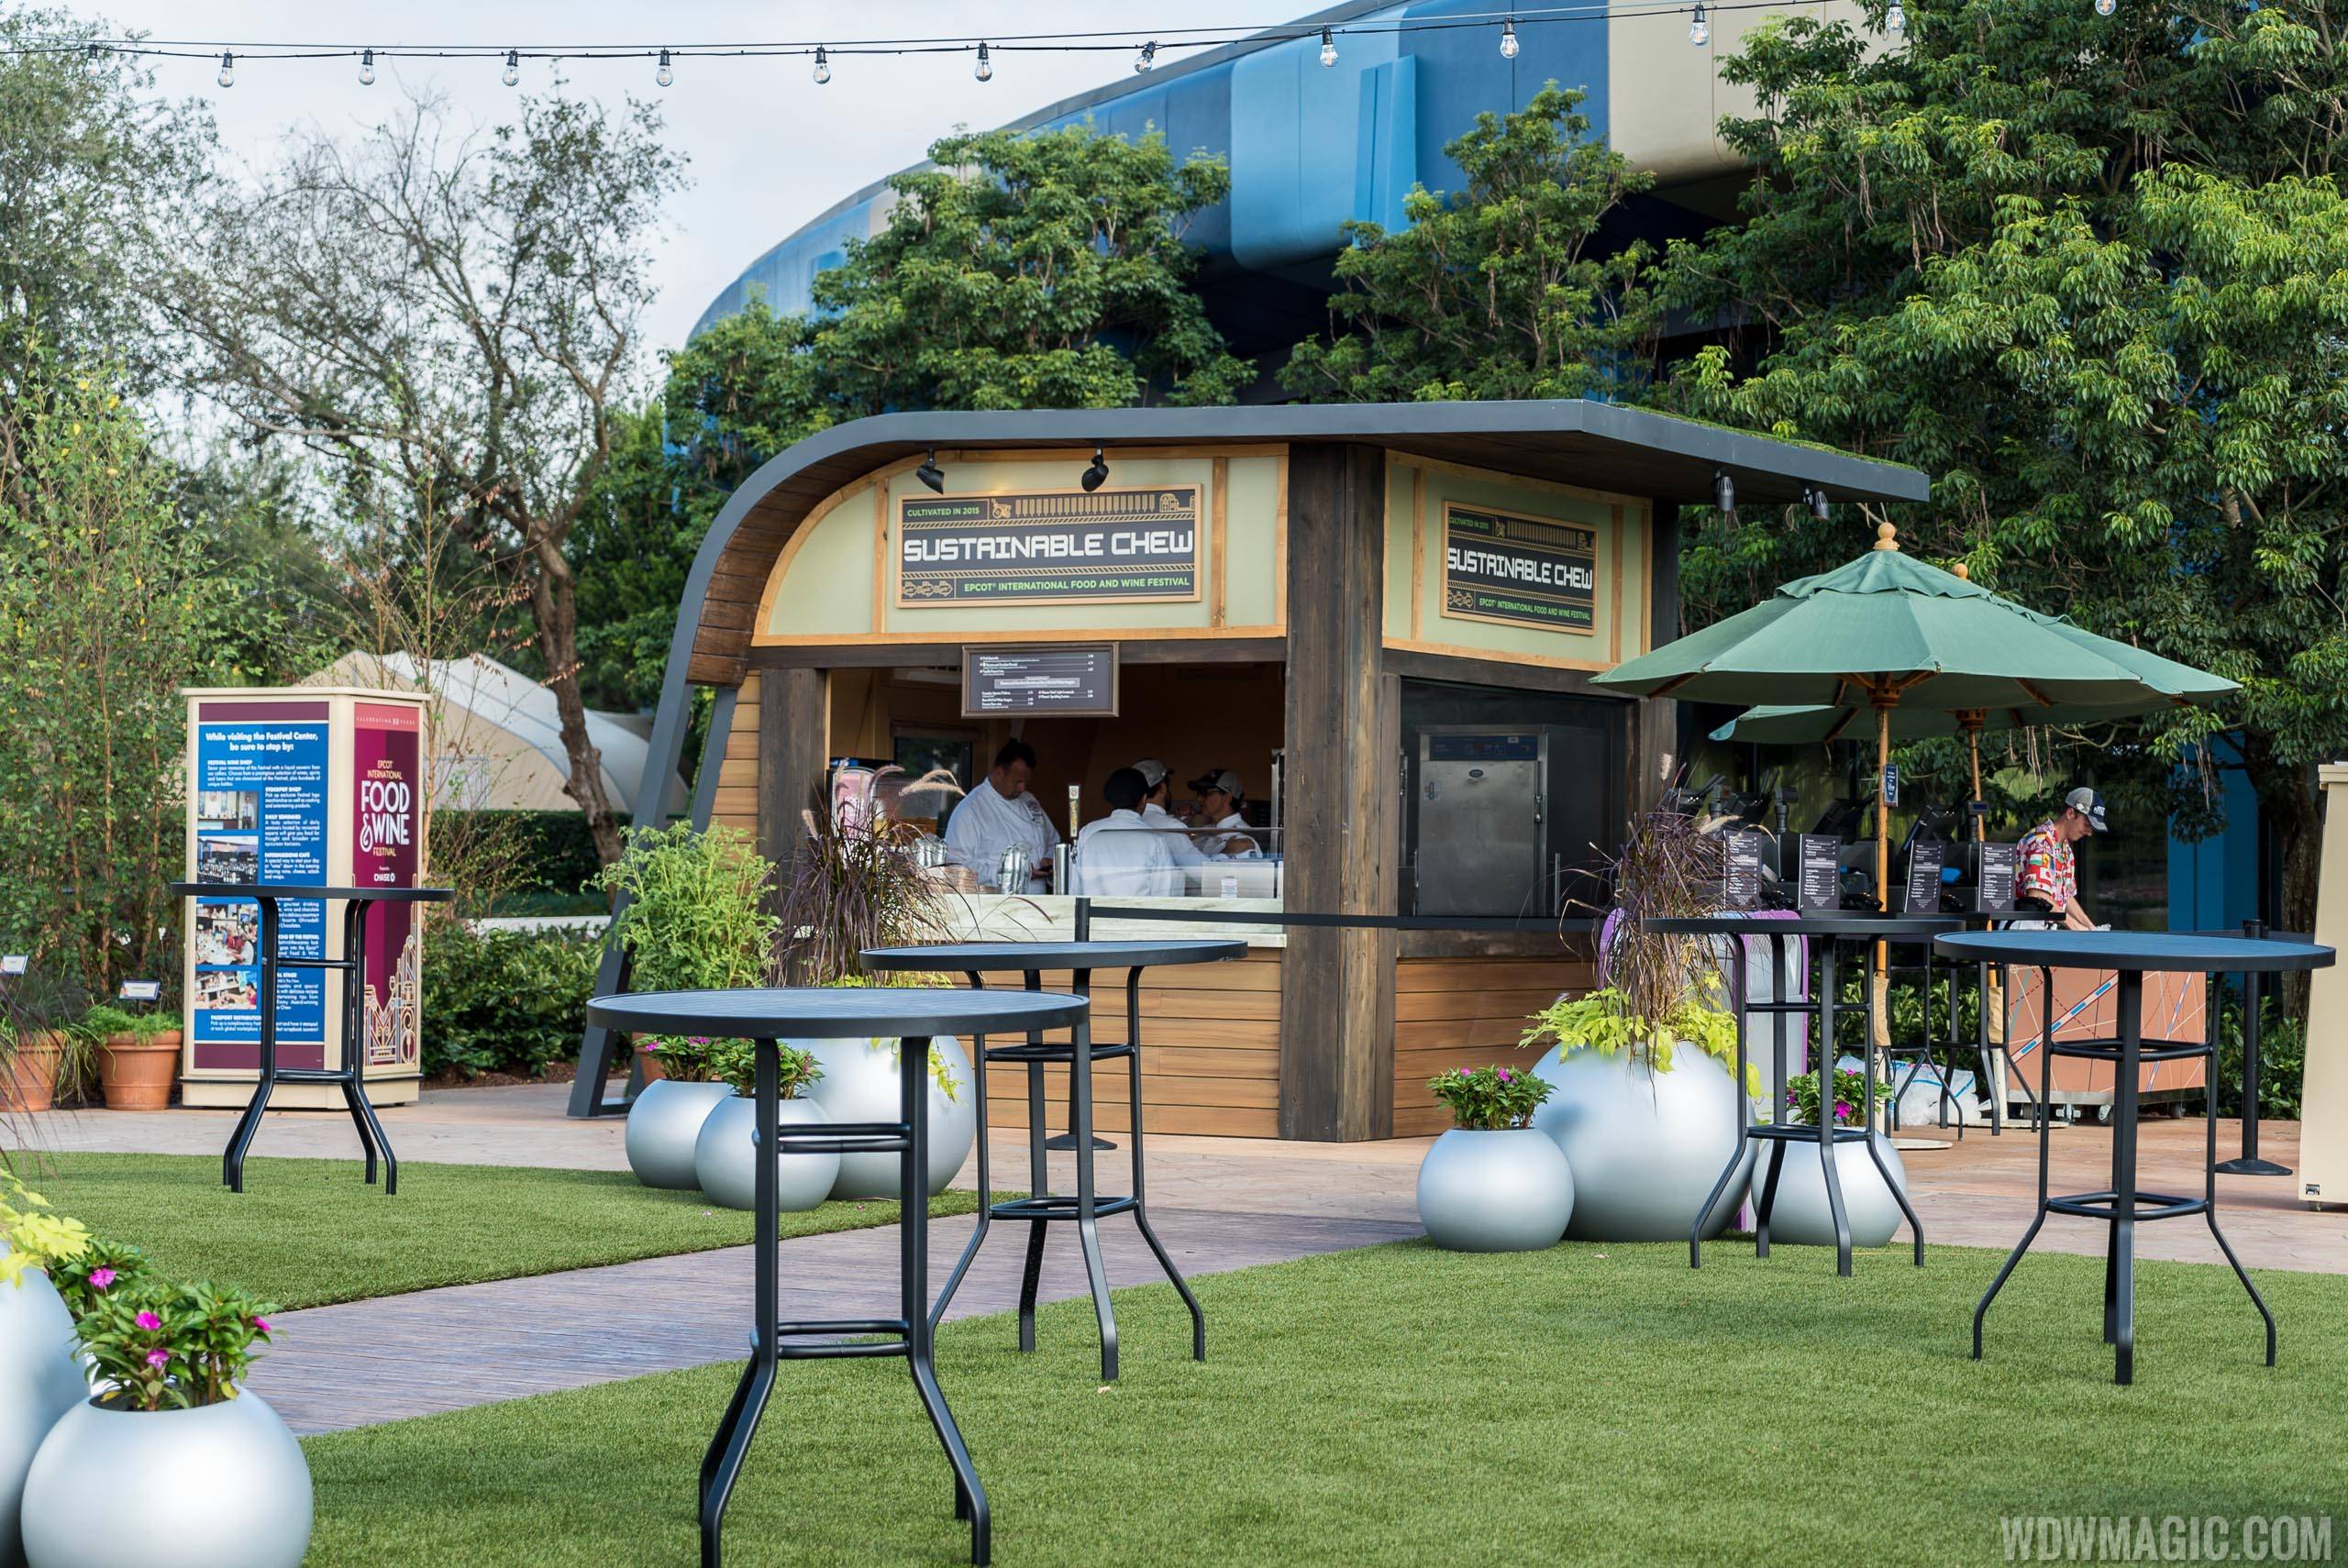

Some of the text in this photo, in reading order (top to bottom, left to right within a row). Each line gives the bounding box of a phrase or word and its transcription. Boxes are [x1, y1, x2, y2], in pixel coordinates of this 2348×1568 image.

[907, 508, 952, 517] CULTIVATED
[963, 506, 980, 514] 2015
[904, 530, 1193, 562] SUSTAINABLE CHEW
[1448, 547, 1593, 590] SUSTAINABLE CHEW
[998, 580, 1069, 591] INTERNATIONAL
[1070, 580, 1097, 589] FOOD
[1099, 579, 1119, 588] AND
[1121, 578, 1146, 587] WINE
[1147, 577, 1189, 587] FESTIVAL
[1497, 601, 1534, 613] INTERNATIONAL
[1534, 605, 1547, 614] FOOD
[1559, 609, 1570, 618] WINE
[1571, 611, 1590, 620] FESTIVAL
[205, 731, 319, 741] While visiting the Festival Center,
[266, 742, 281, 751] stop
[377, 760, 393, 769] EPCOT
[367, 769, 403, 779] INTERNATIONAL
[361, 780, 410, 813] FOOD
[360, 813, 410, 853] & WINE
[373, 847, 396, 857] FESTIVAL
[374, 873, 390, 882] CHASE
